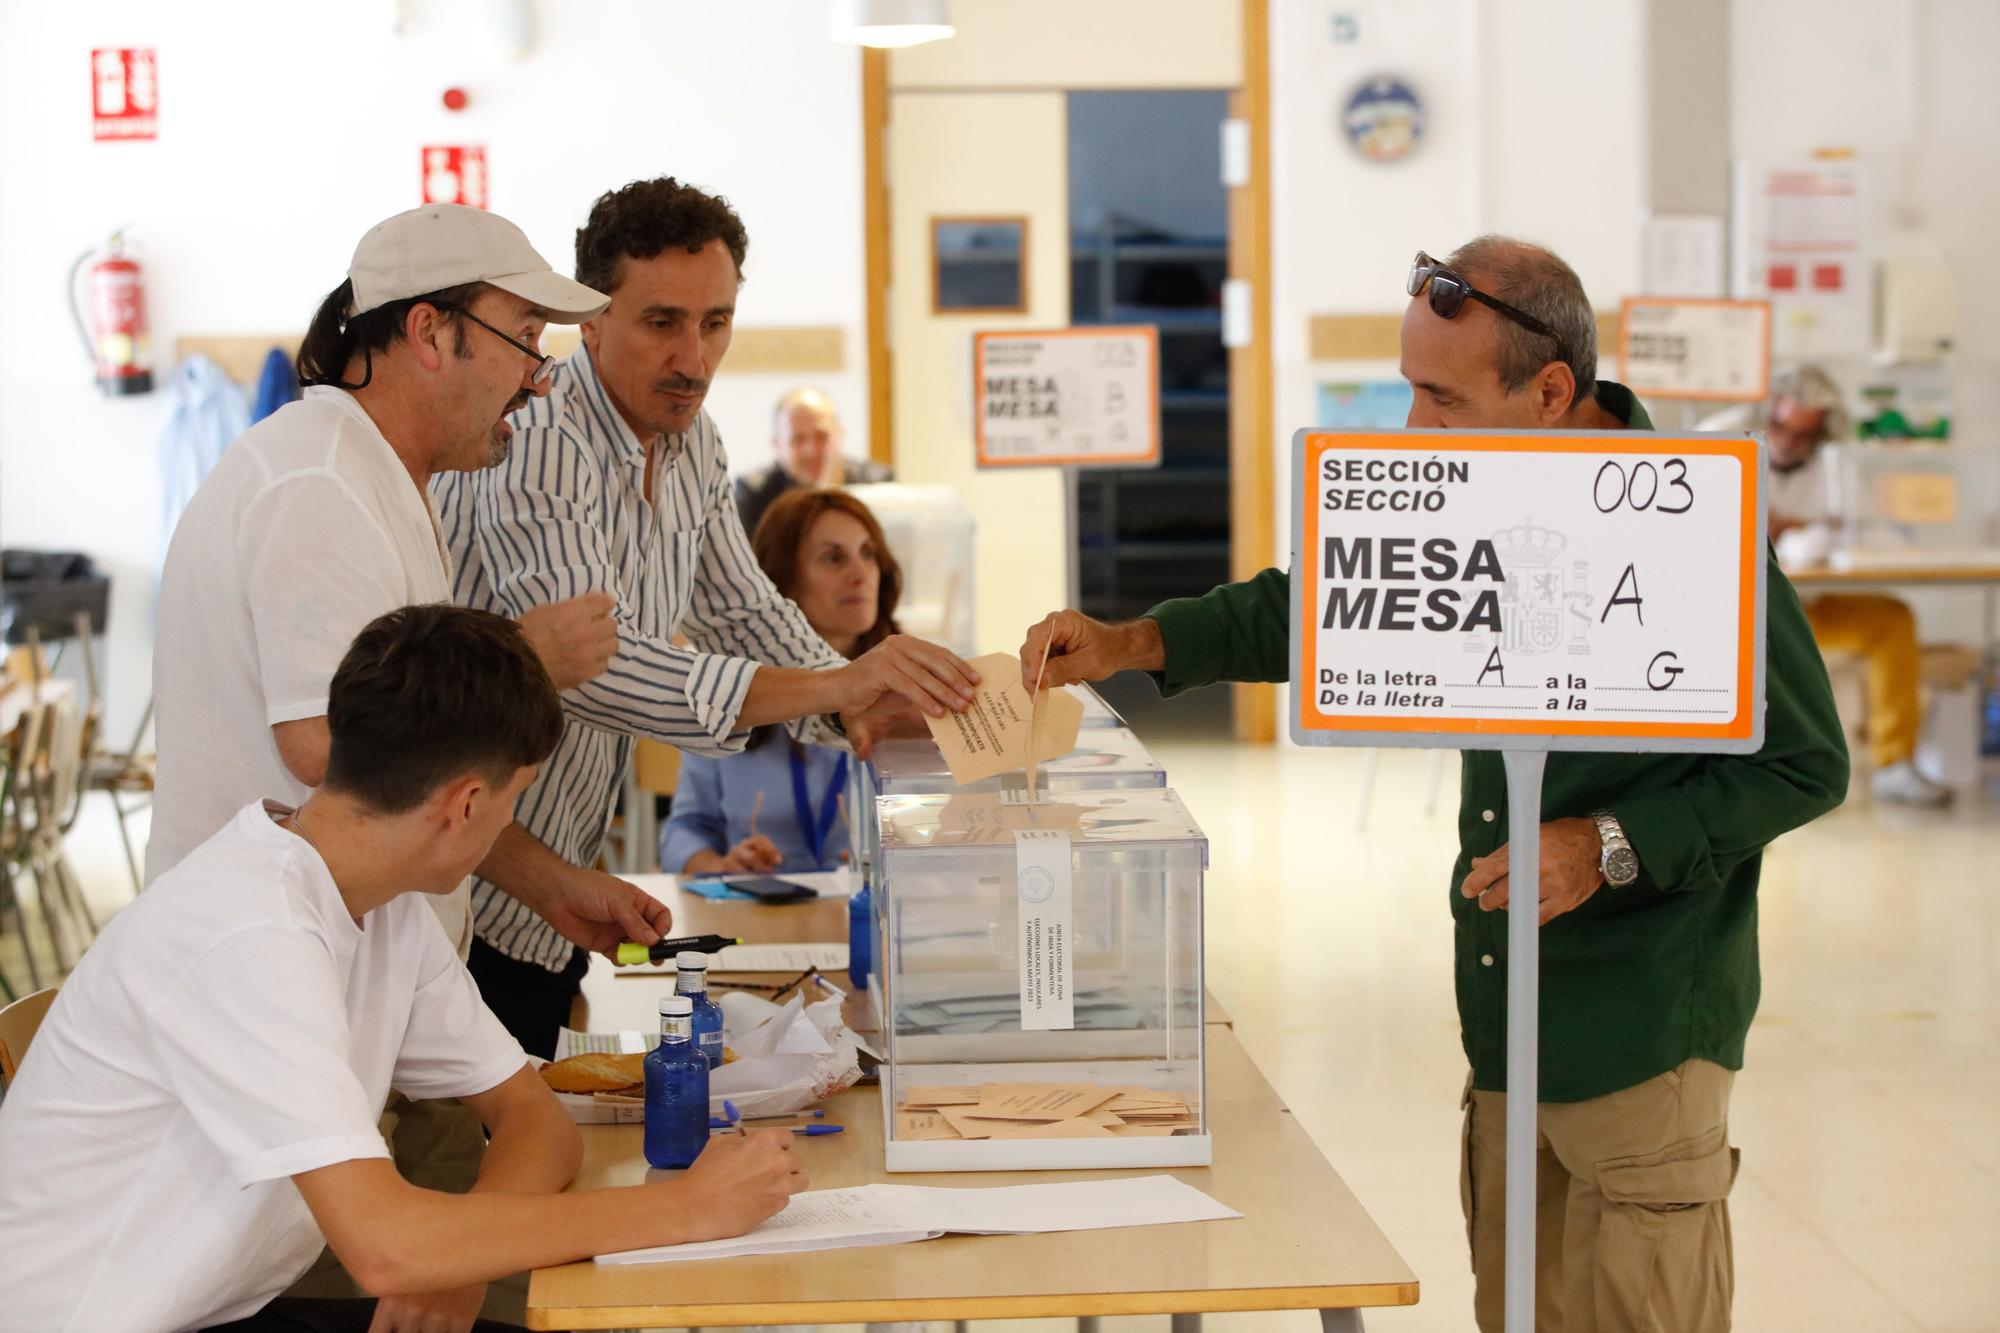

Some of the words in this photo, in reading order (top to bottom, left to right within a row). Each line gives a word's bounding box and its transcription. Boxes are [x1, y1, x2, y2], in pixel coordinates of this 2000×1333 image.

[1323, 455, 1469, 483] SECCIÓN
[1593, 458, 1694, 514] 003
[1324, 485, 1446, 512] SECCIÓ
[1324, 536, 1506, 582] MESA
[1321, 588, 1503, 633] MESA
[1601, 563, 1643, 627] A
[1320, 668, 1348, 685] De
[1357, 669, 1376, 685] la
[1385, 670, 1437, 687] letra
[1477, 645, 1504, 688] A
[1546, 677, 1559, 689] a
[1567, 674, 1587, 690] la
[1646, 651, 1684, 691] G
[1319, 690, 1348, 705] De
[1356, 690, 1376, 706] la
[1384, 691, 1444, 708] lletra
[1546, 697, 1559, 710] a
[1567, 695, 1587, 711] la
[1048, 926, 1054, 935] DE
[1057, 974, 1063, 982] DE
